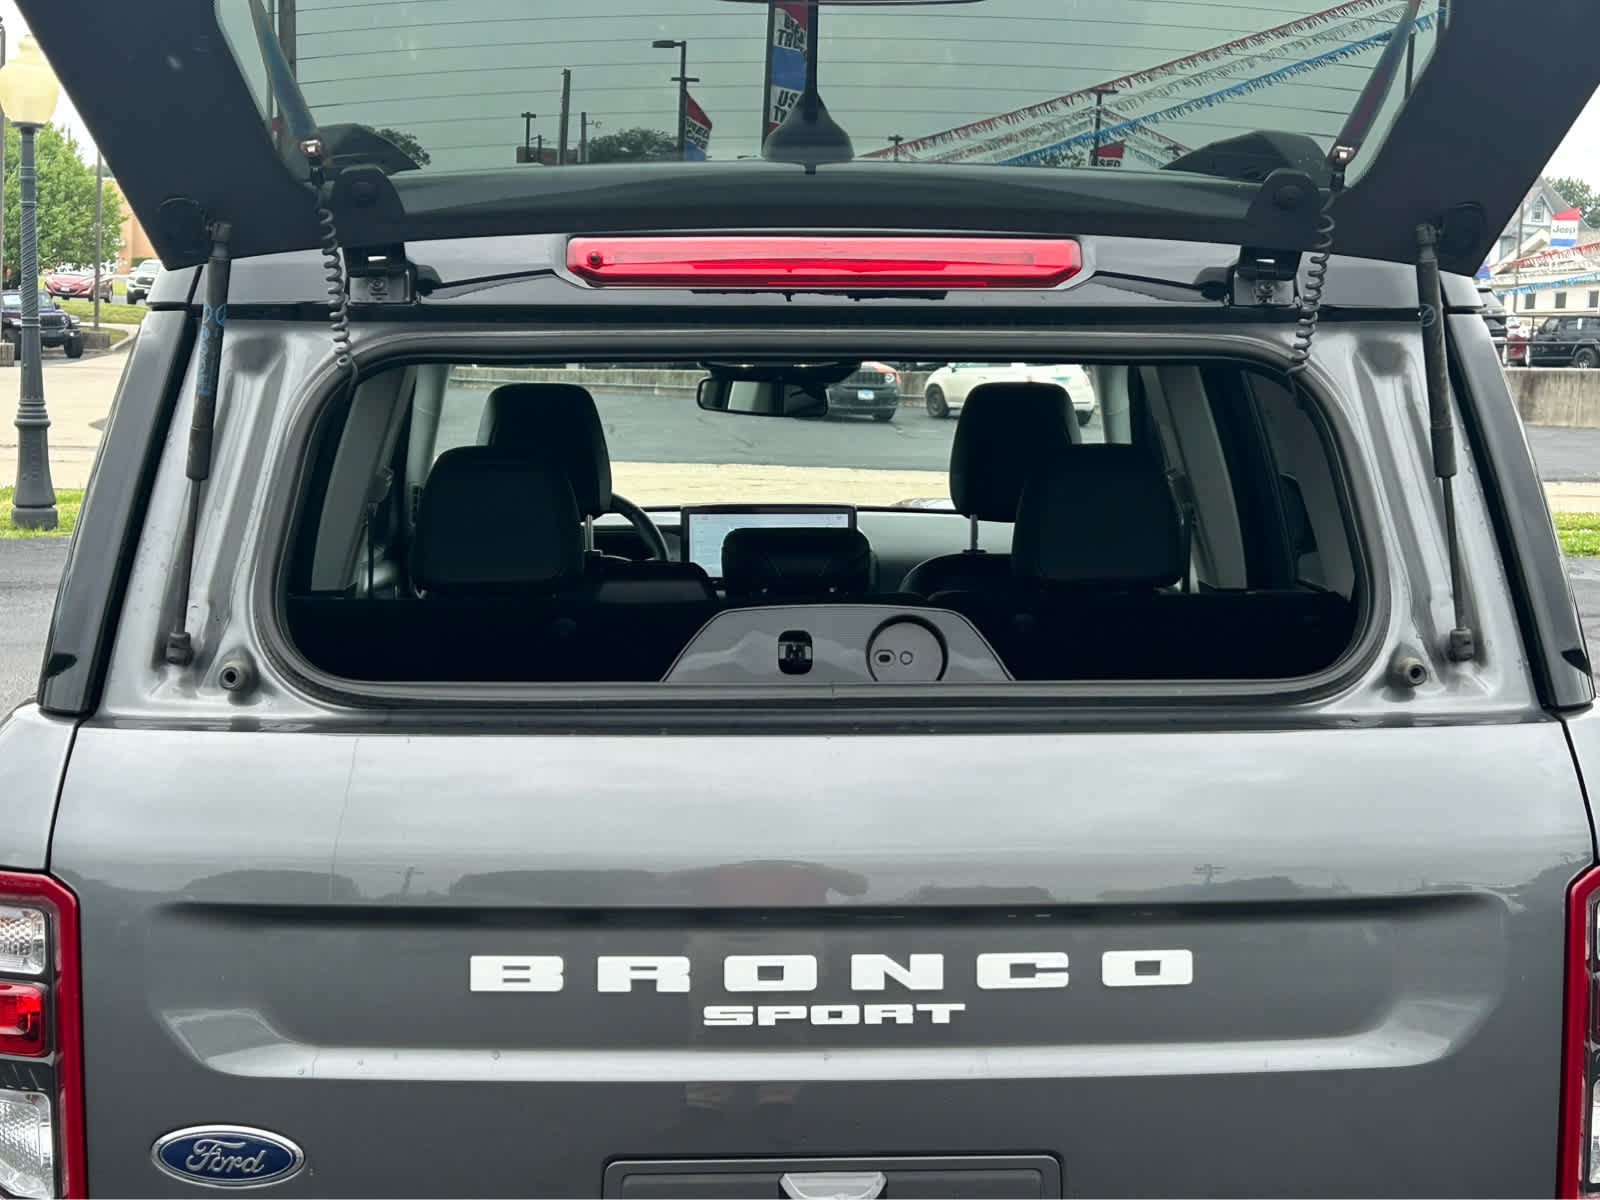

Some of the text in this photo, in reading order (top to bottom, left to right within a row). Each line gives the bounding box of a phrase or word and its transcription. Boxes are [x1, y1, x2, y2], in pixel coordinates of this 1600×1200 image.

[1553, 225, 1576, 235] Jeep
[470, 949, 1193, 992] BRONCO
[703, 1003, 966, 1026] SPORT
[185, 1138, 267, 1174] Ford
